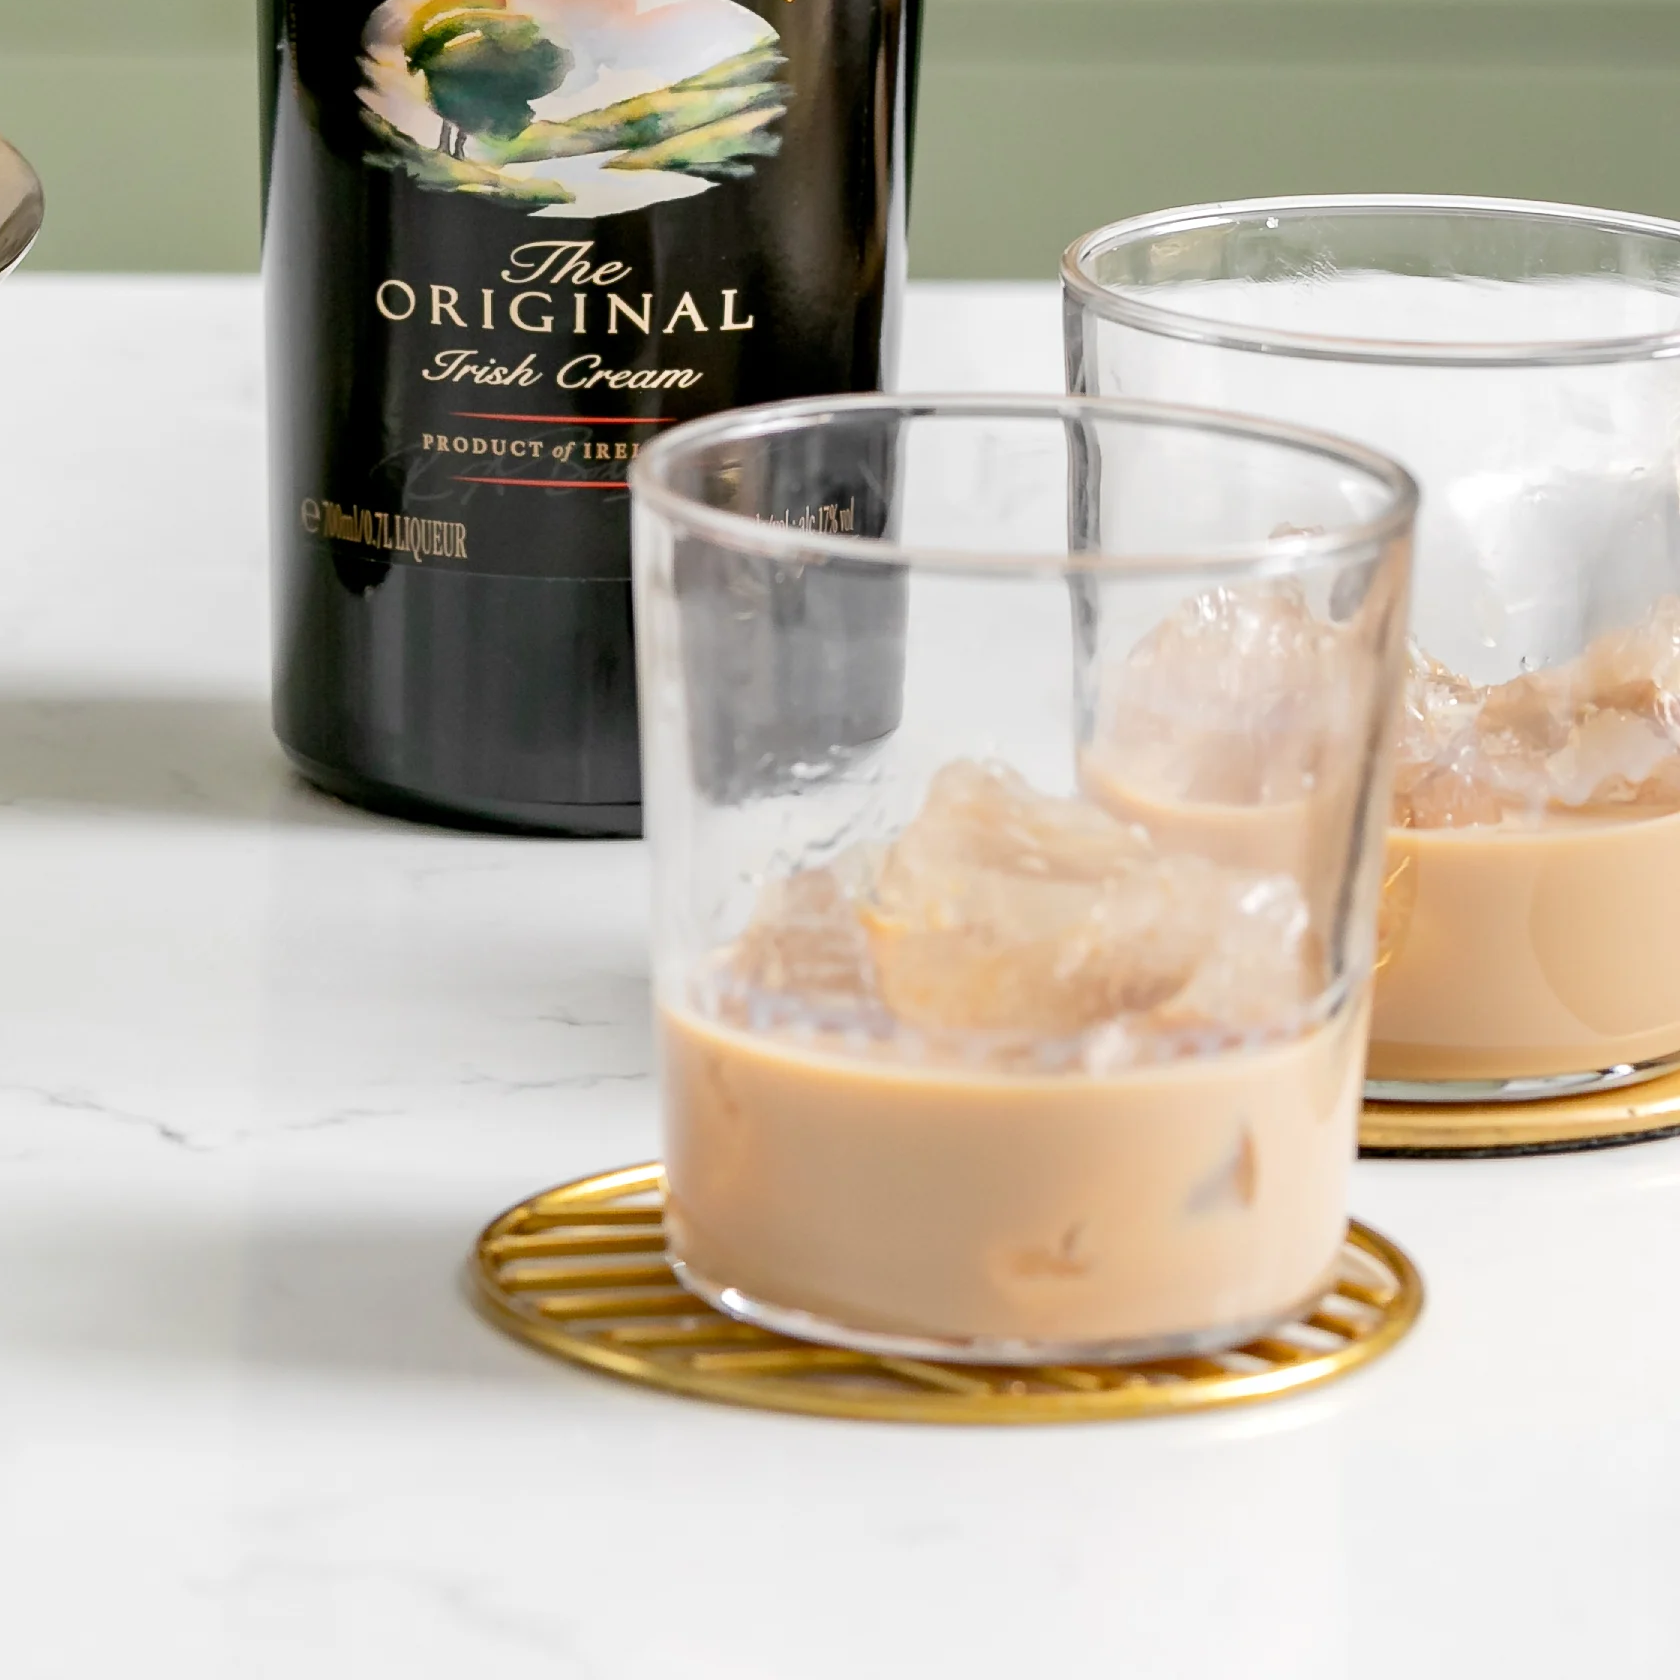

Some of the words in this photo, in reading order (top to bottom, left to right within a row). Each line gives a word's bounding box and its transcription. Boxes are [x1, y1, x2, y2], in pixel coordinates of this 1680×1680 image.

[501, 240, 632, 286] The
[375, 278, 755, 335] ORIGINAL
[421, 349, 543, 388] Irish
[556, 353, 704, 389] Cream
[422, 432, 544, 458] PRODUCT
[551, 440, 576, 462] of
[393, 514, 468, 563] LIQUEUR
